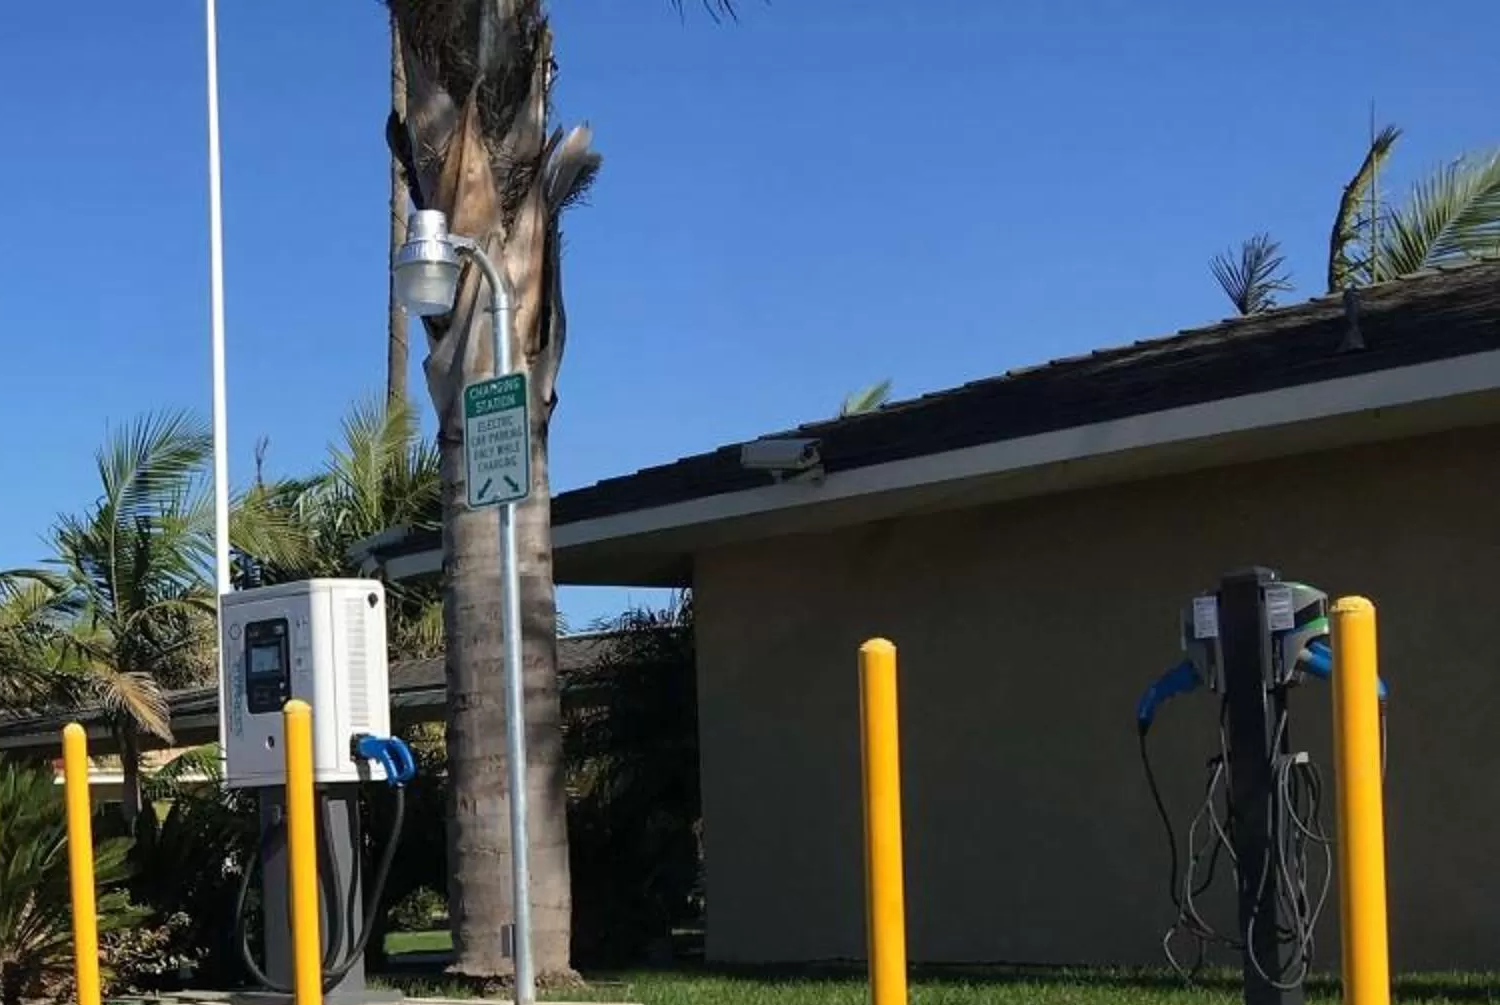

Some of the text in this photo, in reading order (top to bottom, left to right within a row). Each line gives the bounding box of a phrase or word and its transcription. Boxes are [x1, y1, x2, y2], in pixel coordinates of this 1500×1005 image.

[476, 394, 516, 413] STATION
[477, 415, 514, 432] ELECTRIC
[472, 433, 486, 448] CAR
